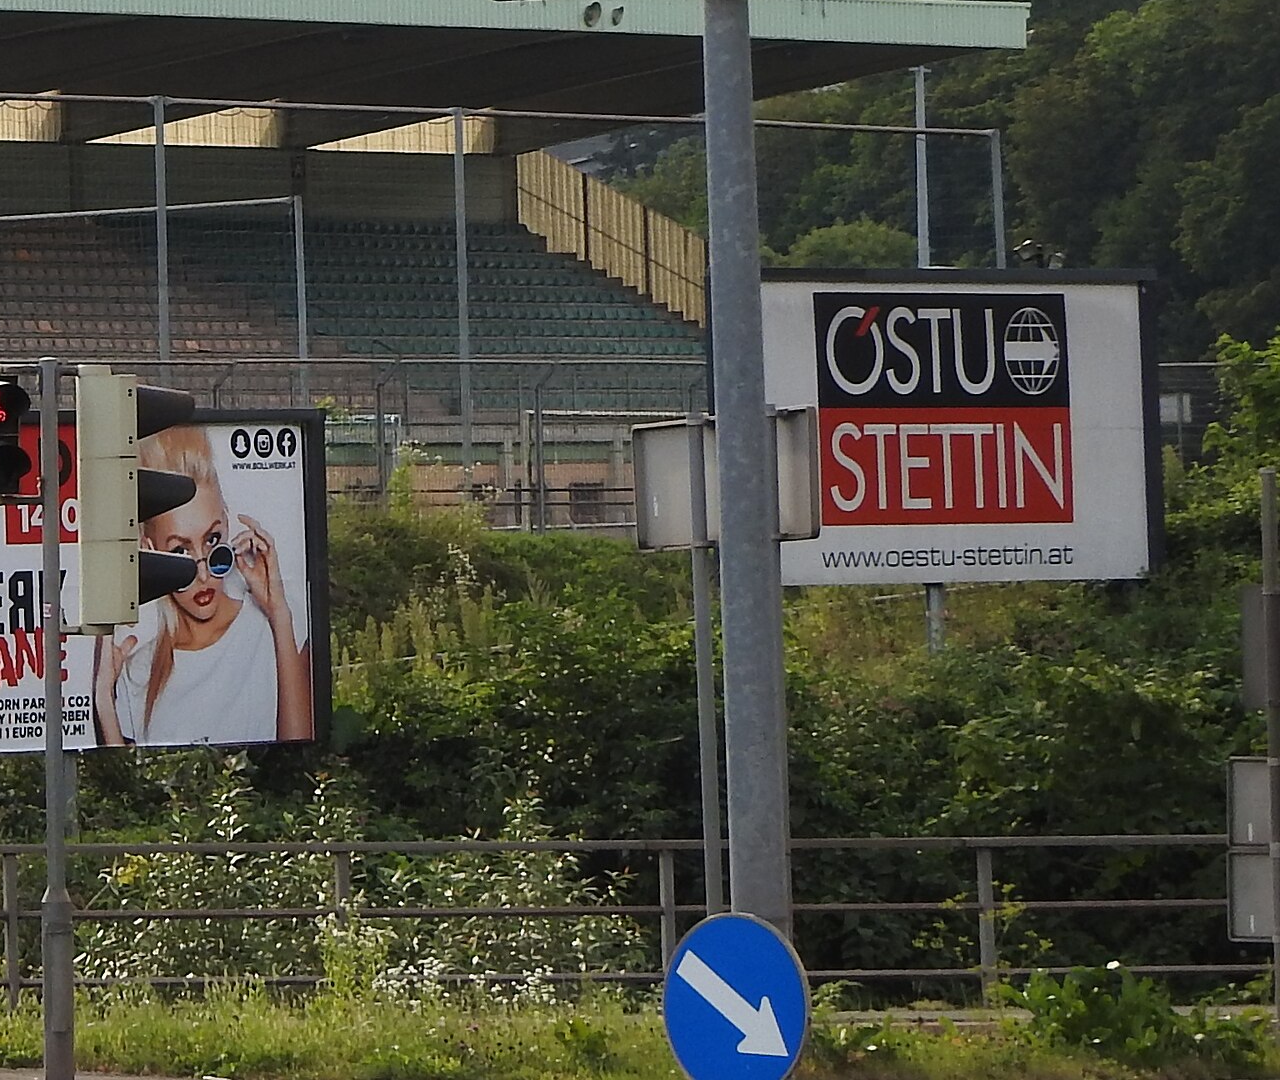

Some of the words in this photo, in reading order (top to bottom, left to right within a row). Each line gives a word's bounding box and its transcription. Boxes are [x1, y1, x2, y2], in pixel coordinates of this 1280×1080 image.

[232, 461, 296, 471] WWW.BOLLWERK.AT
[829, 421, 1065, 512] STETTIN
[822, 544, 1074, 568] www.oestu-stettin.at
[23, 697, 45, 709] PAR
[68, 696, 90, 707] CO2
[15, 710, 89, 724] NEONRBEN
[12, 725, 43, 739] EURO
